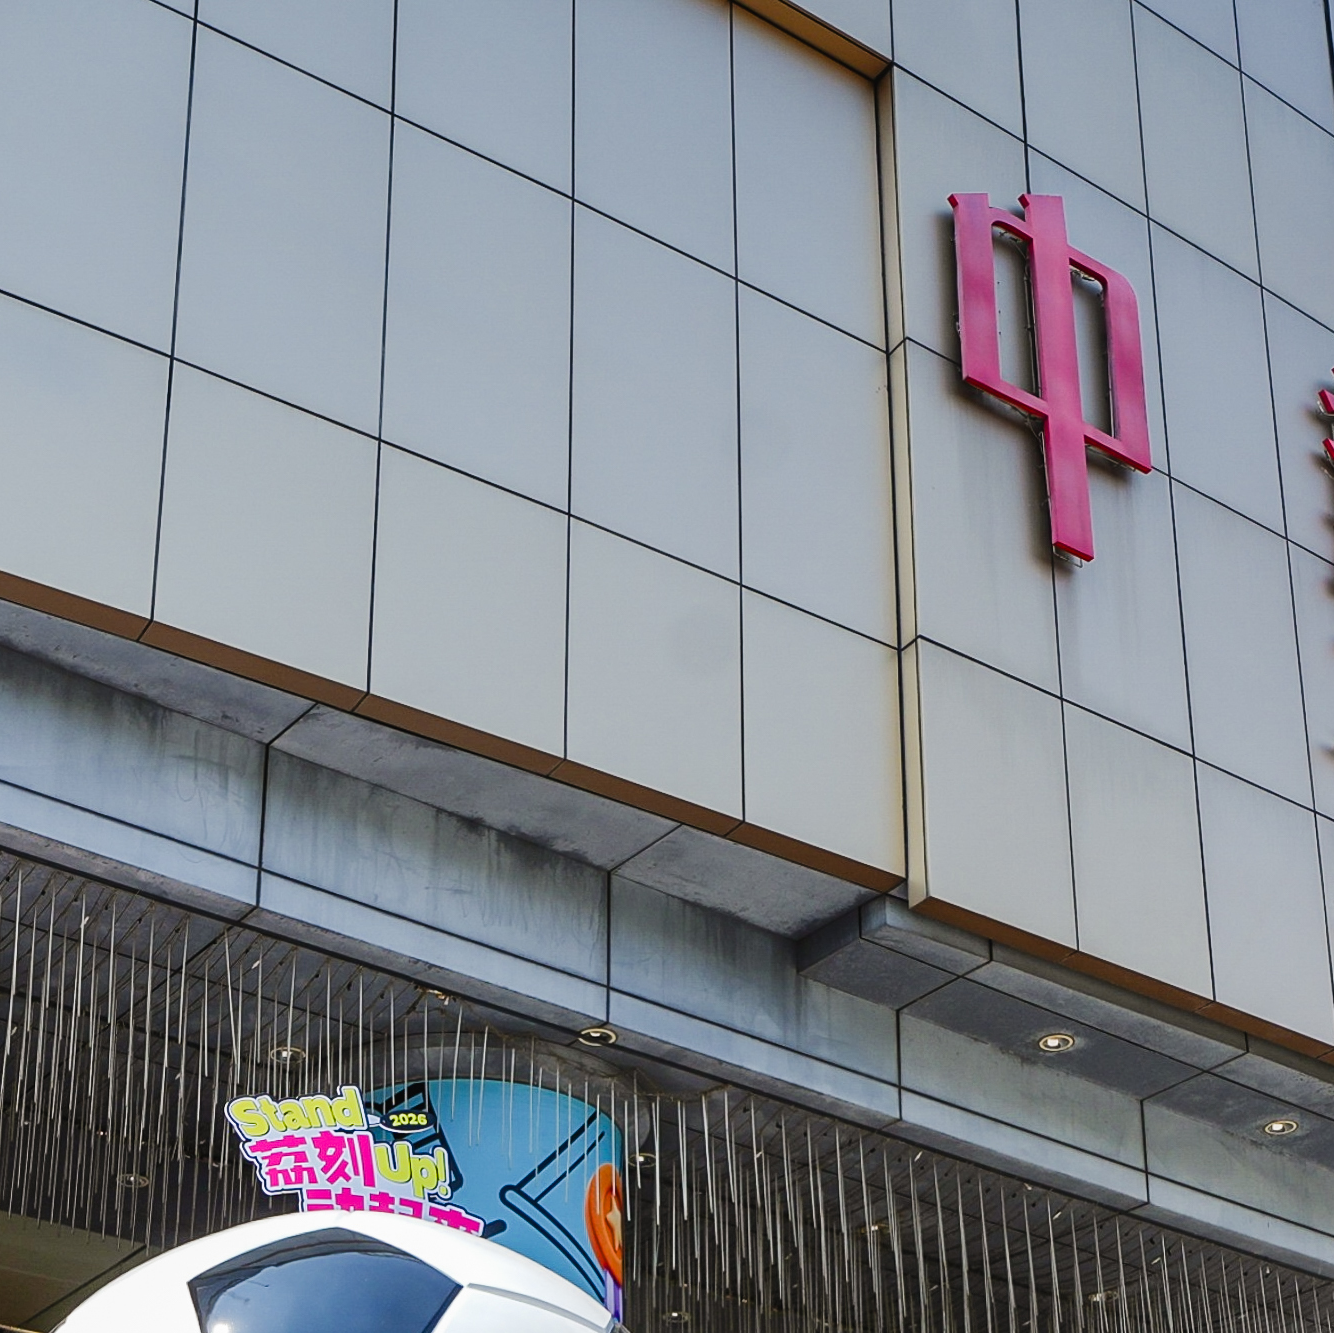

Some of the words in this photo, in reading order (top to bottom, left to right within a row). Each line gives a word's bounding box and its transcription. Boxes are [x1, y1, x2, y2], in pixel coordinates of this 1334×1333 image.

[229, 1086, 365, 1137] Stand
[388, 1112, 429, 1127] 2026
[248, 1130, 377, 1189] 荔刻
[374, 1143, 450, 1199] Up!
